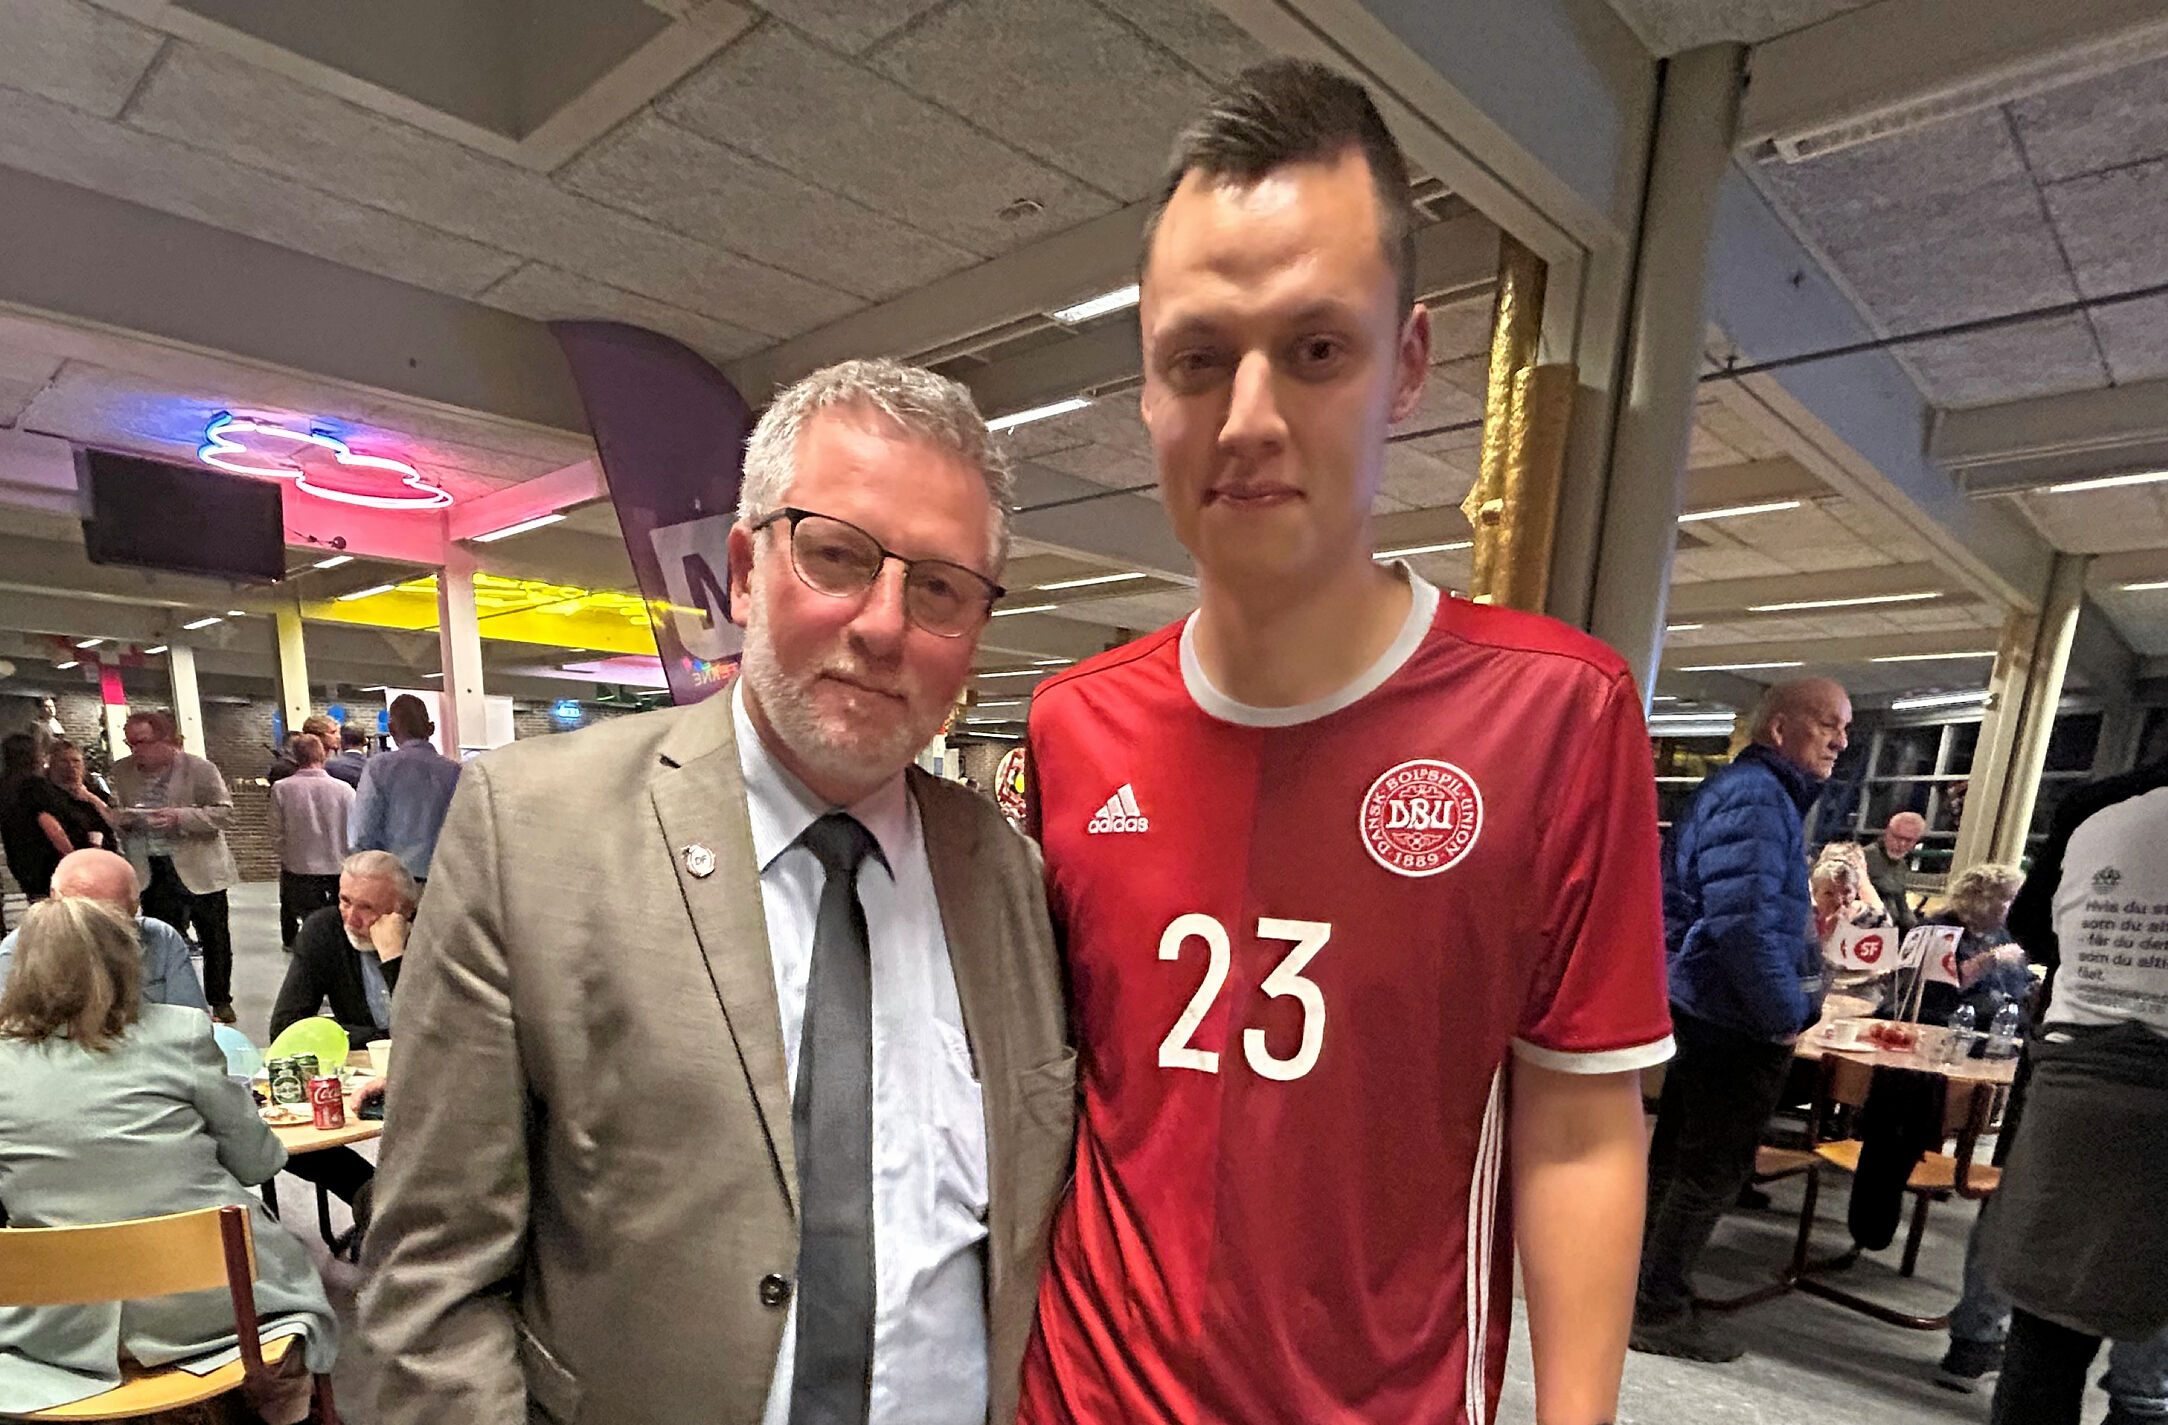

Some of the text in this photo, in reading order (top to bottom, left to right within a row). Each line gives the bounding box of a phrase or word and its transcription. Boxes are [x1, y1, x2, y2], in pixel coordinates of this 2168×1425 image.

[1087, 814, 1149, 834] adidas
[1367, 792, 1391, 854] DANSK
[1445, 798, 1474, 857] UNION
[1385, 798, 1455, 830] DBU
[1393, 852, 1439, 868] 1889
[1859, 941, 1880, 957] SF
[1158, 913, 1332, 1081] 23
